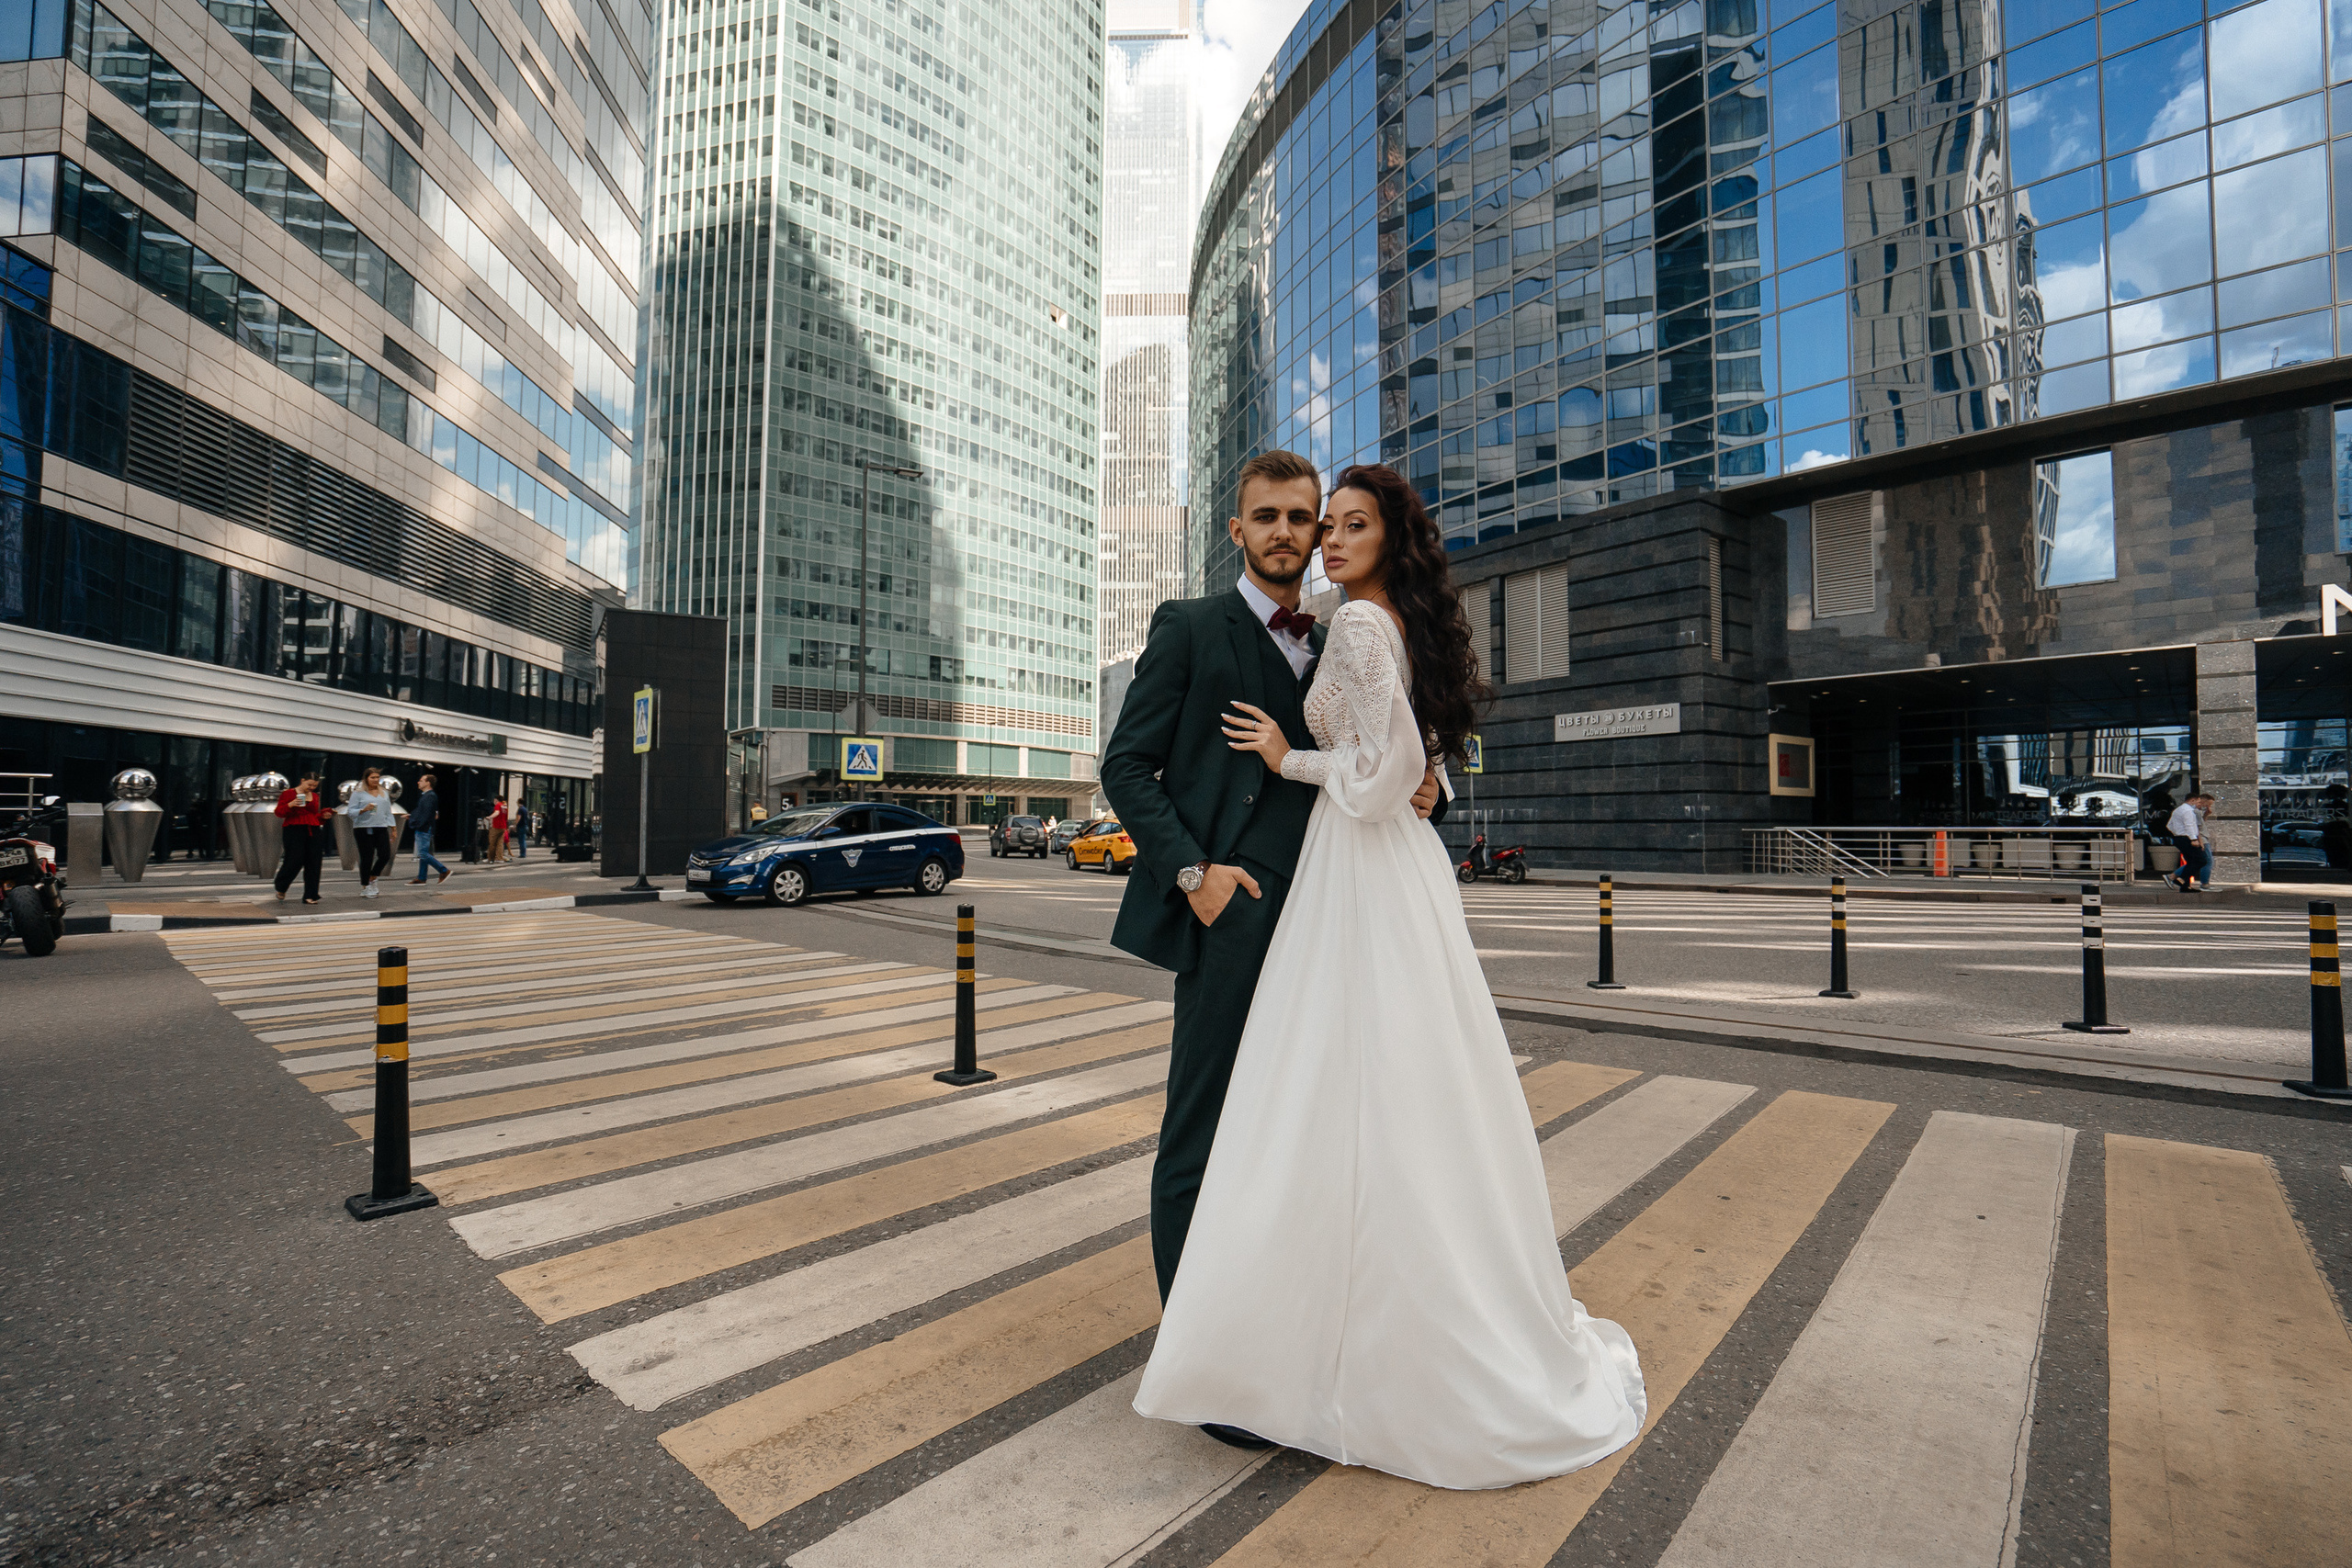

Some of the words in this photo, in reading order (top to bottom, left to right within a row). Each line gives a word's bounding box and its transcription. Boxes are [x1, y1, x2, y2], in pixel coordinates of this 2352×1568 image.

[1558, 715, 1600, 728] ЦВЕТЫ
[1619, 707, 1672, 722] БУКЕТЫ
[1582, 728, 1609, 737] FLOWER
[1612, 724, 1645, 735] BOUTIQUE
